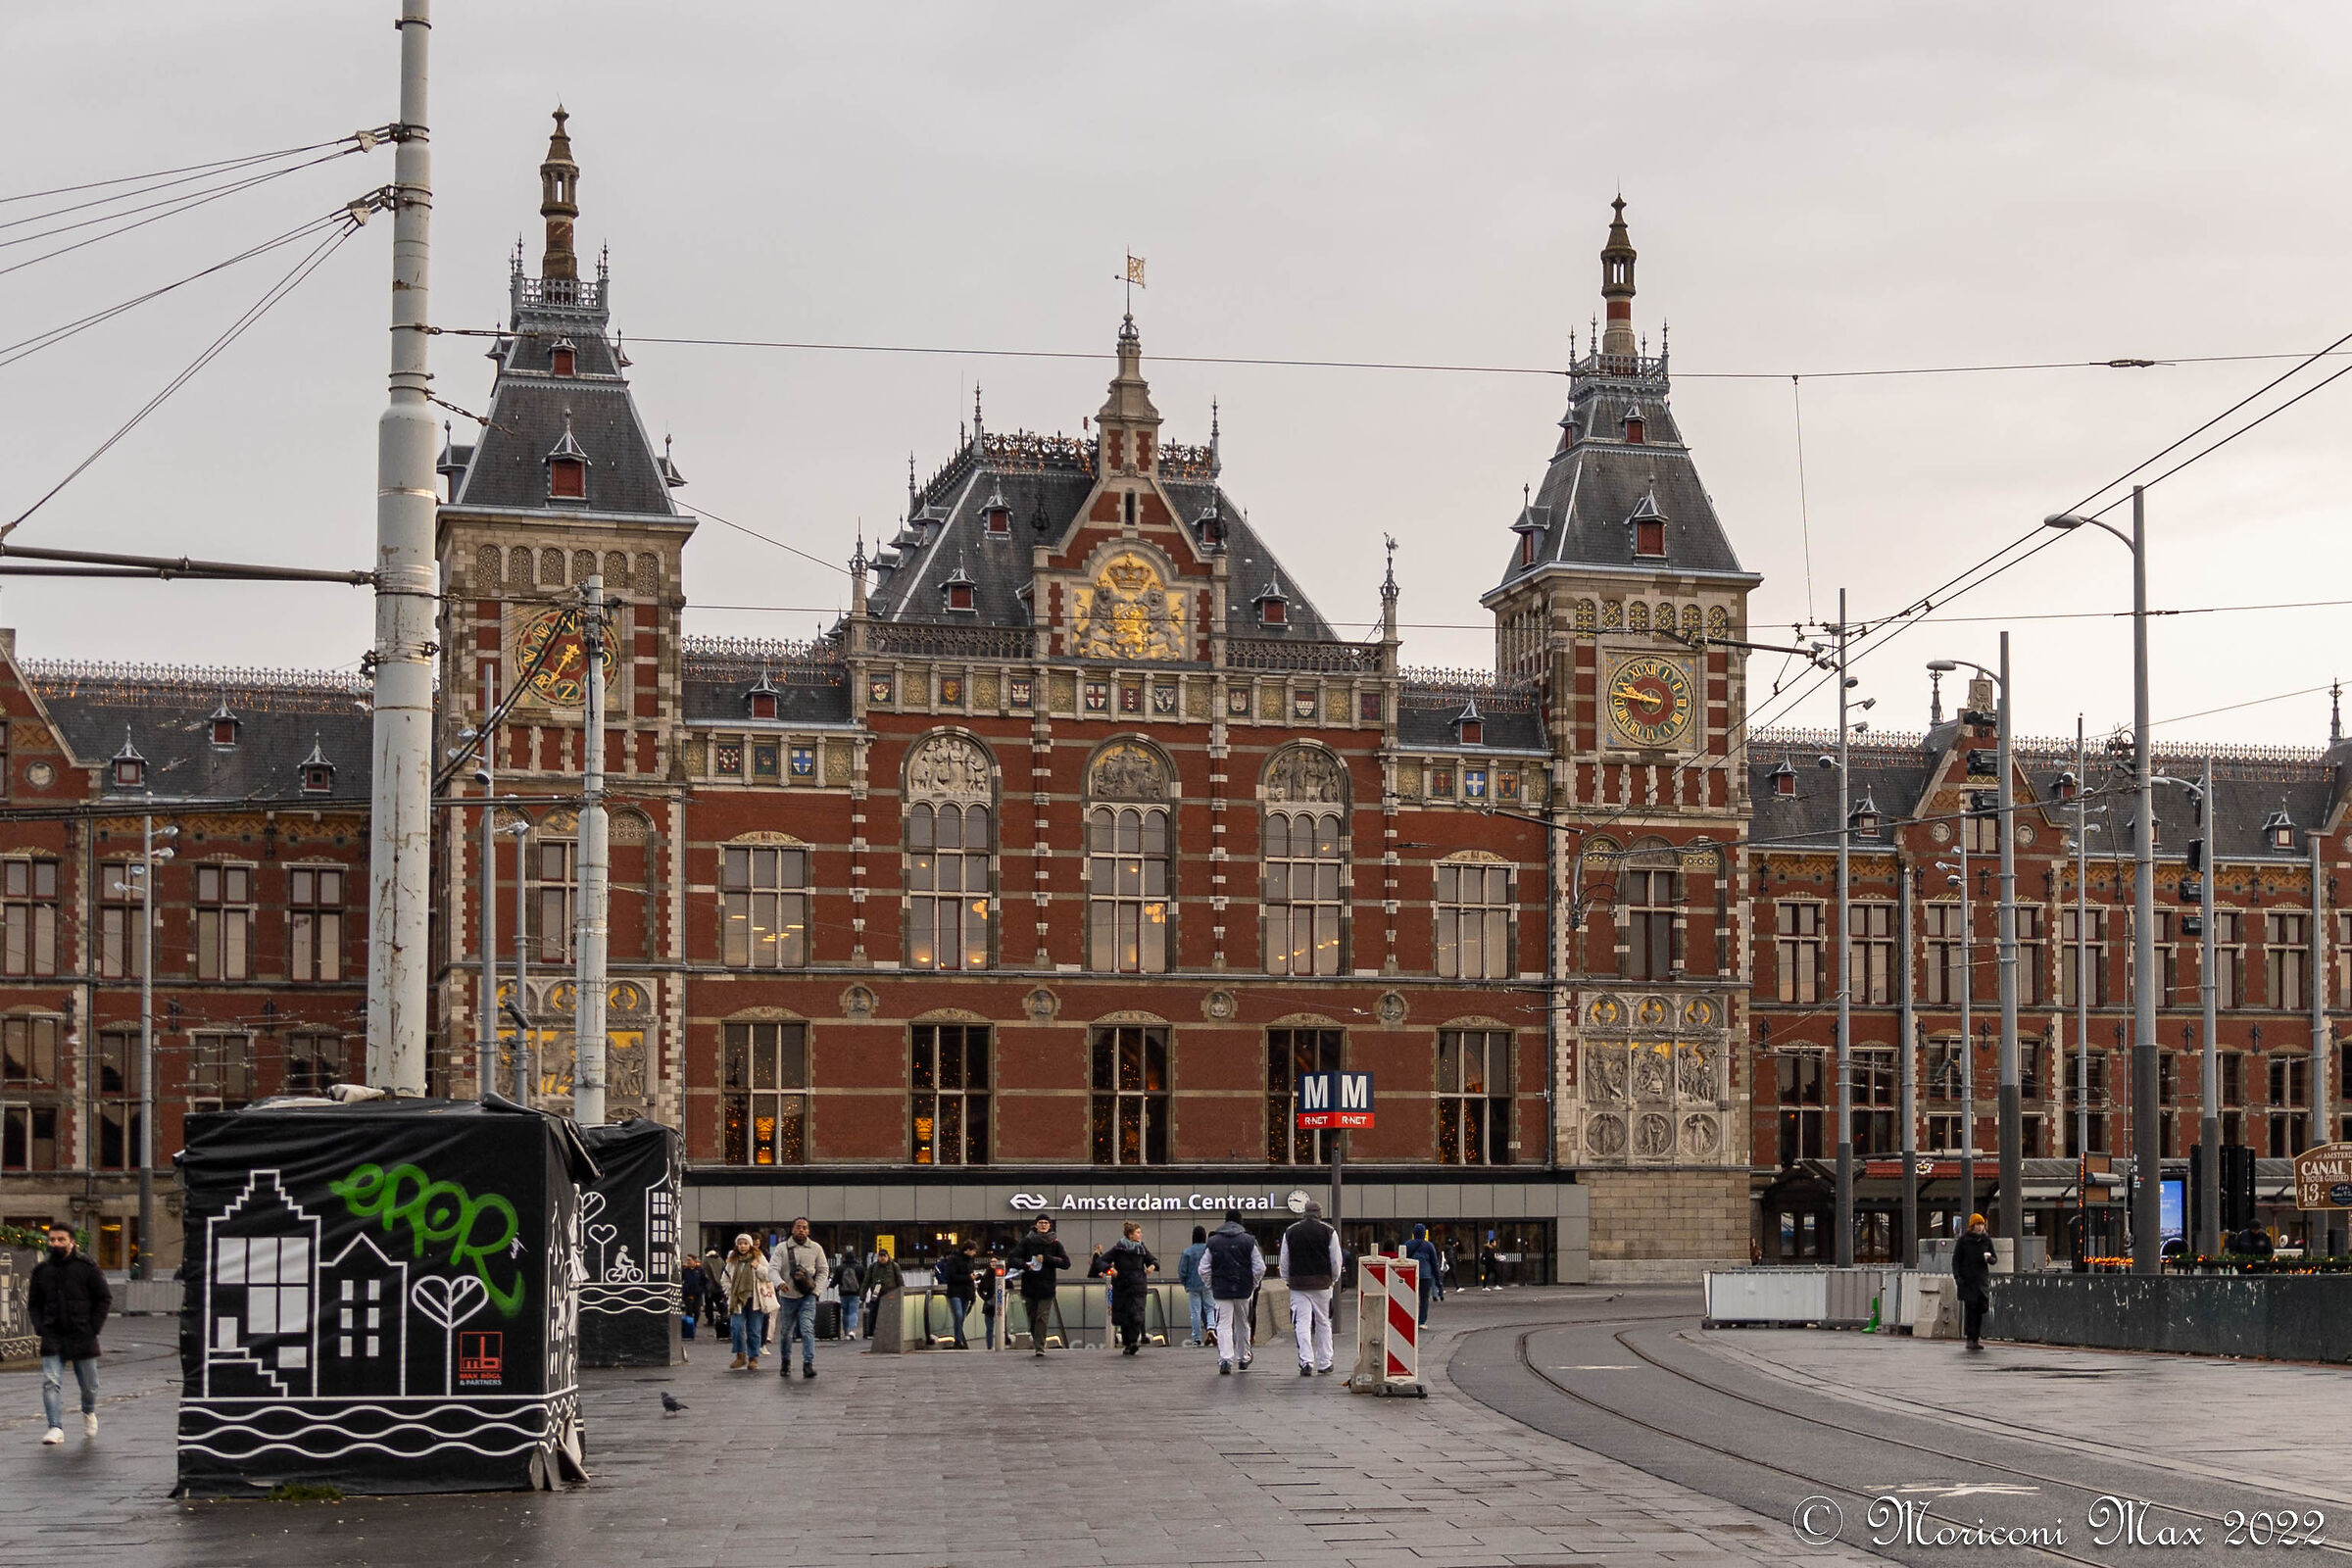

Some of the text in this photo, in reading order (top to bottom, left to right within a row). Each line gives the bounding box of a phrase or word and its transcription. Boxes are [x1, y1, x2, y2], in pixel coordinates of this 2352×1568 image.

[1629, 666, 1642, 679] XI
[1644, 663, 1656, 675] XII
[1662, 669, 1670, 679] I
[561, 683, 575, 699] Z
[1672, 681, 1684, 692] II
[1676, 698, 1688, 708] III
[1304, 1074, 1328, 1109] M
[1342, 1074, 1367, 1108] M
[2301, 1160, 2346, 1176] CANAL
[1060, 1192, 1275, 1210] Amsterdam Centraal
